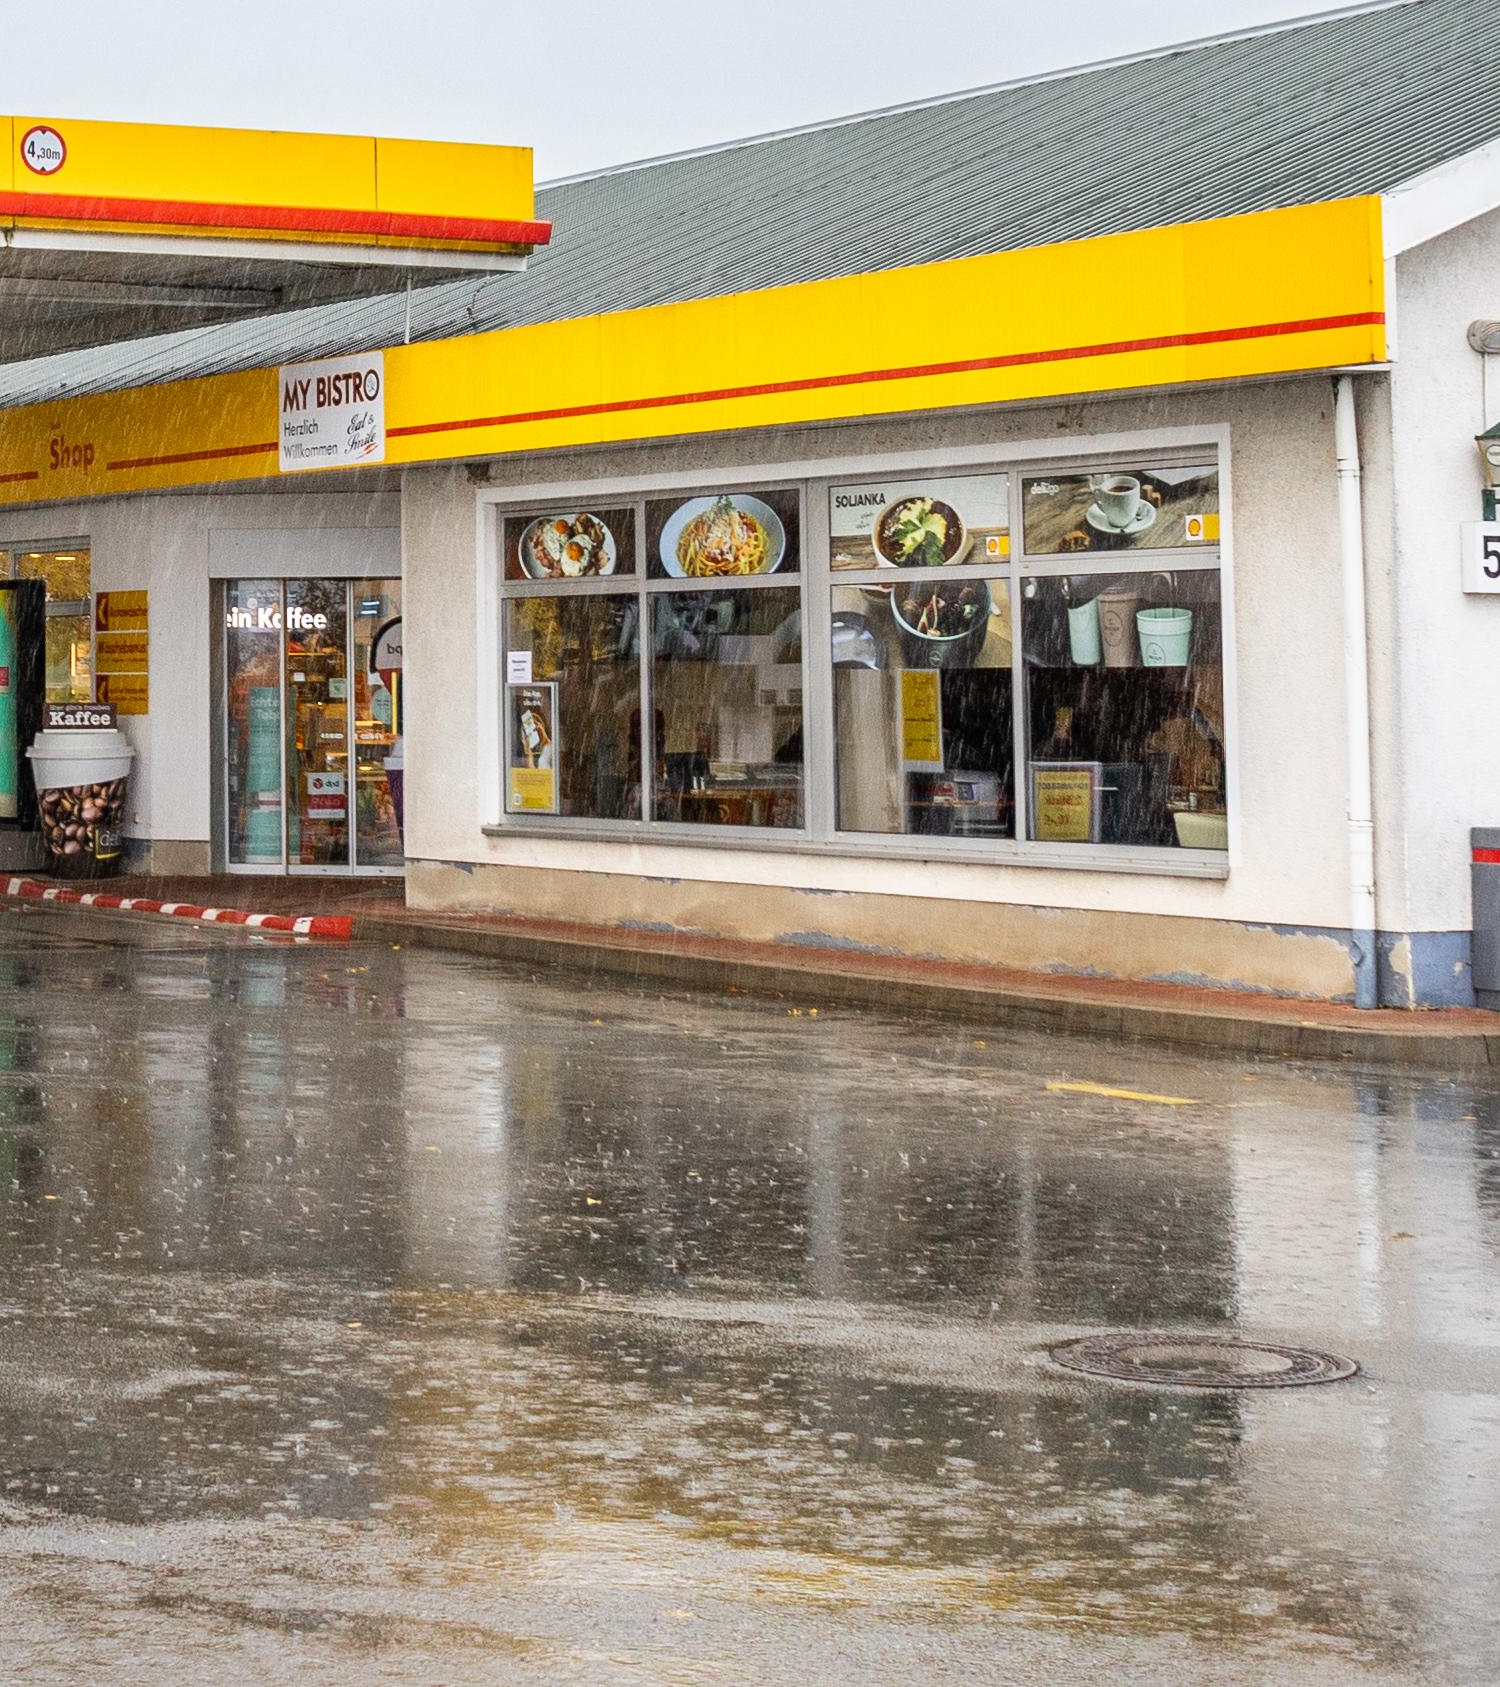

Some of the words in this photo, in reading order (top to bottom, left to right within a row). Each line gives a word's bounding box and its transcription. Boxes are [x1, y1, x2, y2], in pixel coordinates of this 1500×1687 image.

[27, 140, 61, 161] 4,30m
[283, 378, 311, 413] MY
[316, 368, 380, 408] BISTRO
[283, 418, 319, 436] Herzlich
[347, 411, 369, 435] Eat
[49, 435, 95, 475] Shop
[283, 443, 338, 459] Willkommen
[48, 711, 111, 726] Kaffee
